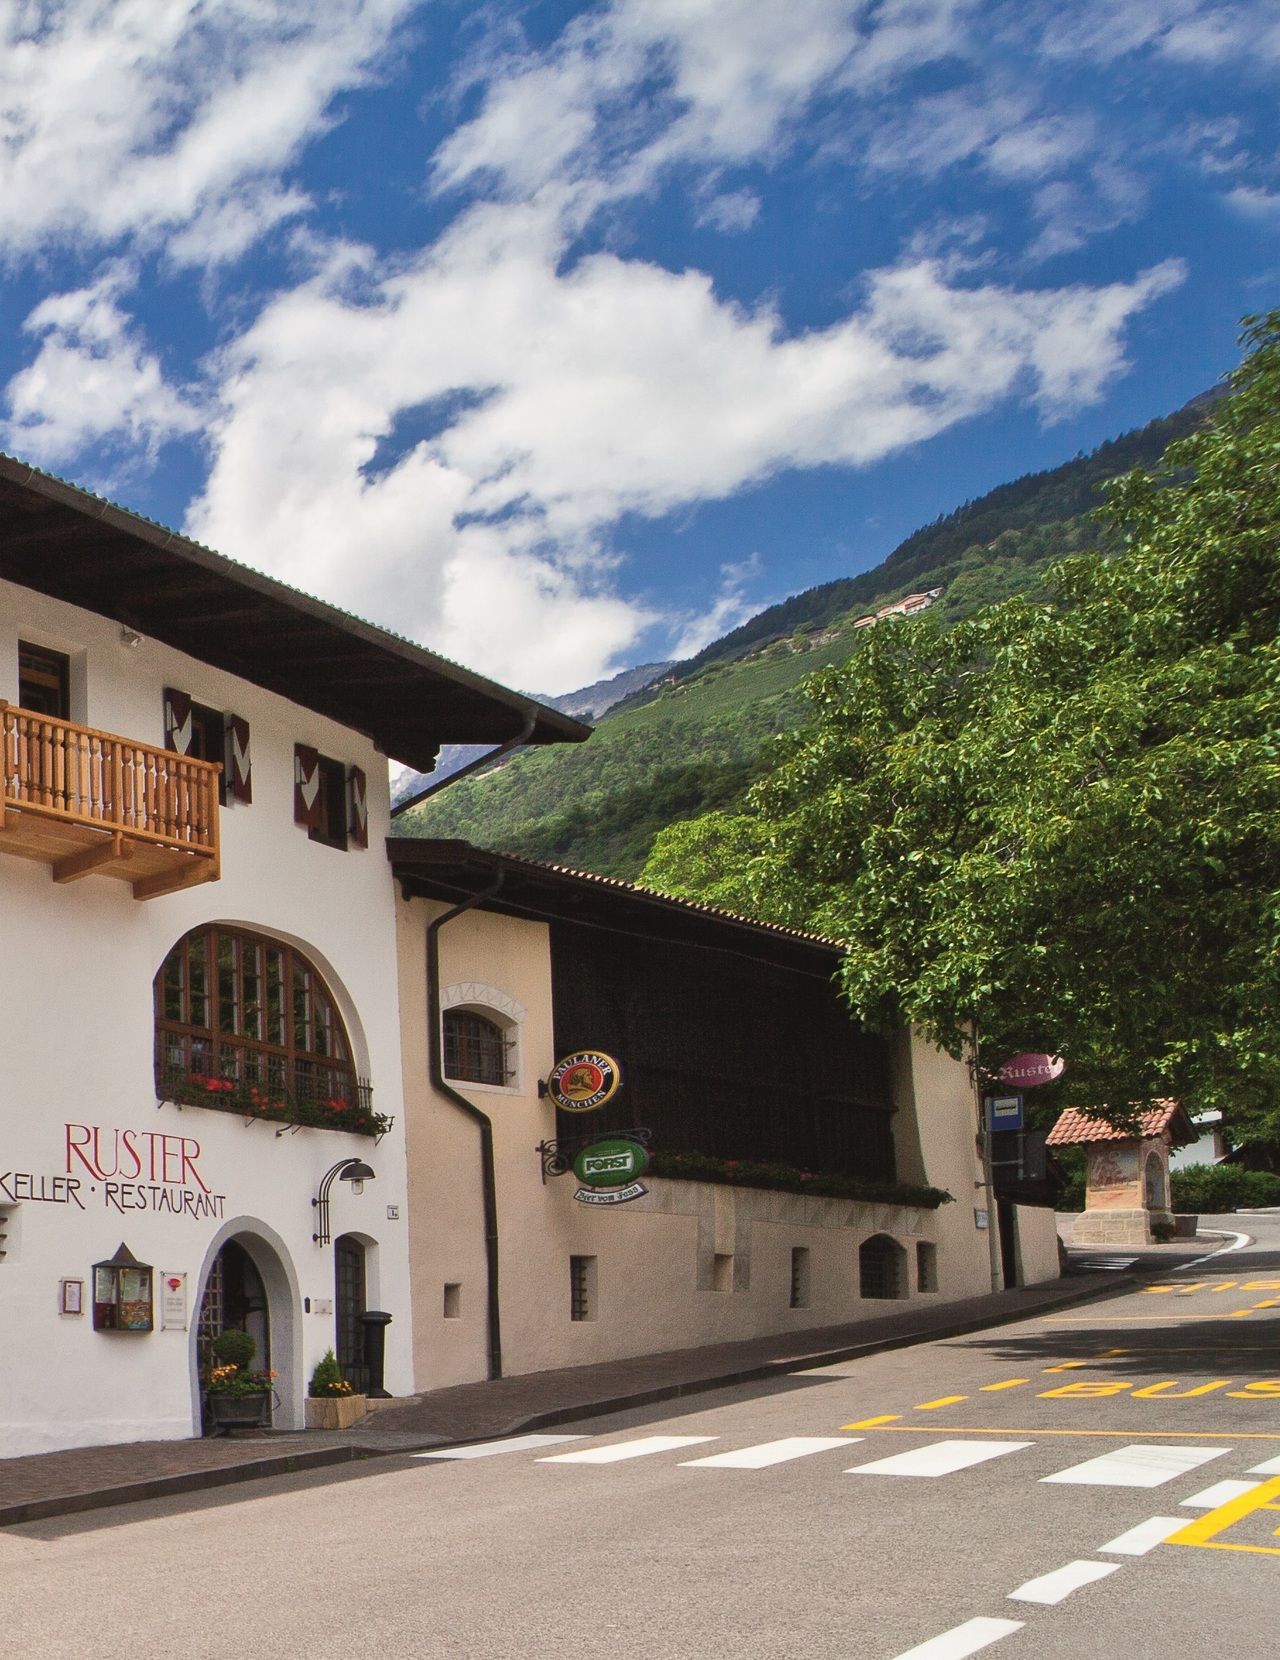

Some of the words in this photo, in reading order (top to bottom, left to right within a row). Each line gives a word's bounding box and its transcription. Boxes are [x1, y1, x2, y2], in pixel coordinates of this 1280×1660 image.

[553, 1054, 612, 1080] PAULANER
[1000, 1065, 1055, 1079] Ruste
[64, 1123, 212, 1194] RUSTER
[586, 1156, 631, 1172] FORST
[105, 1182, 226, 1220] RESTAURANT
[1036, 1380, 1280, 1399] BUS
